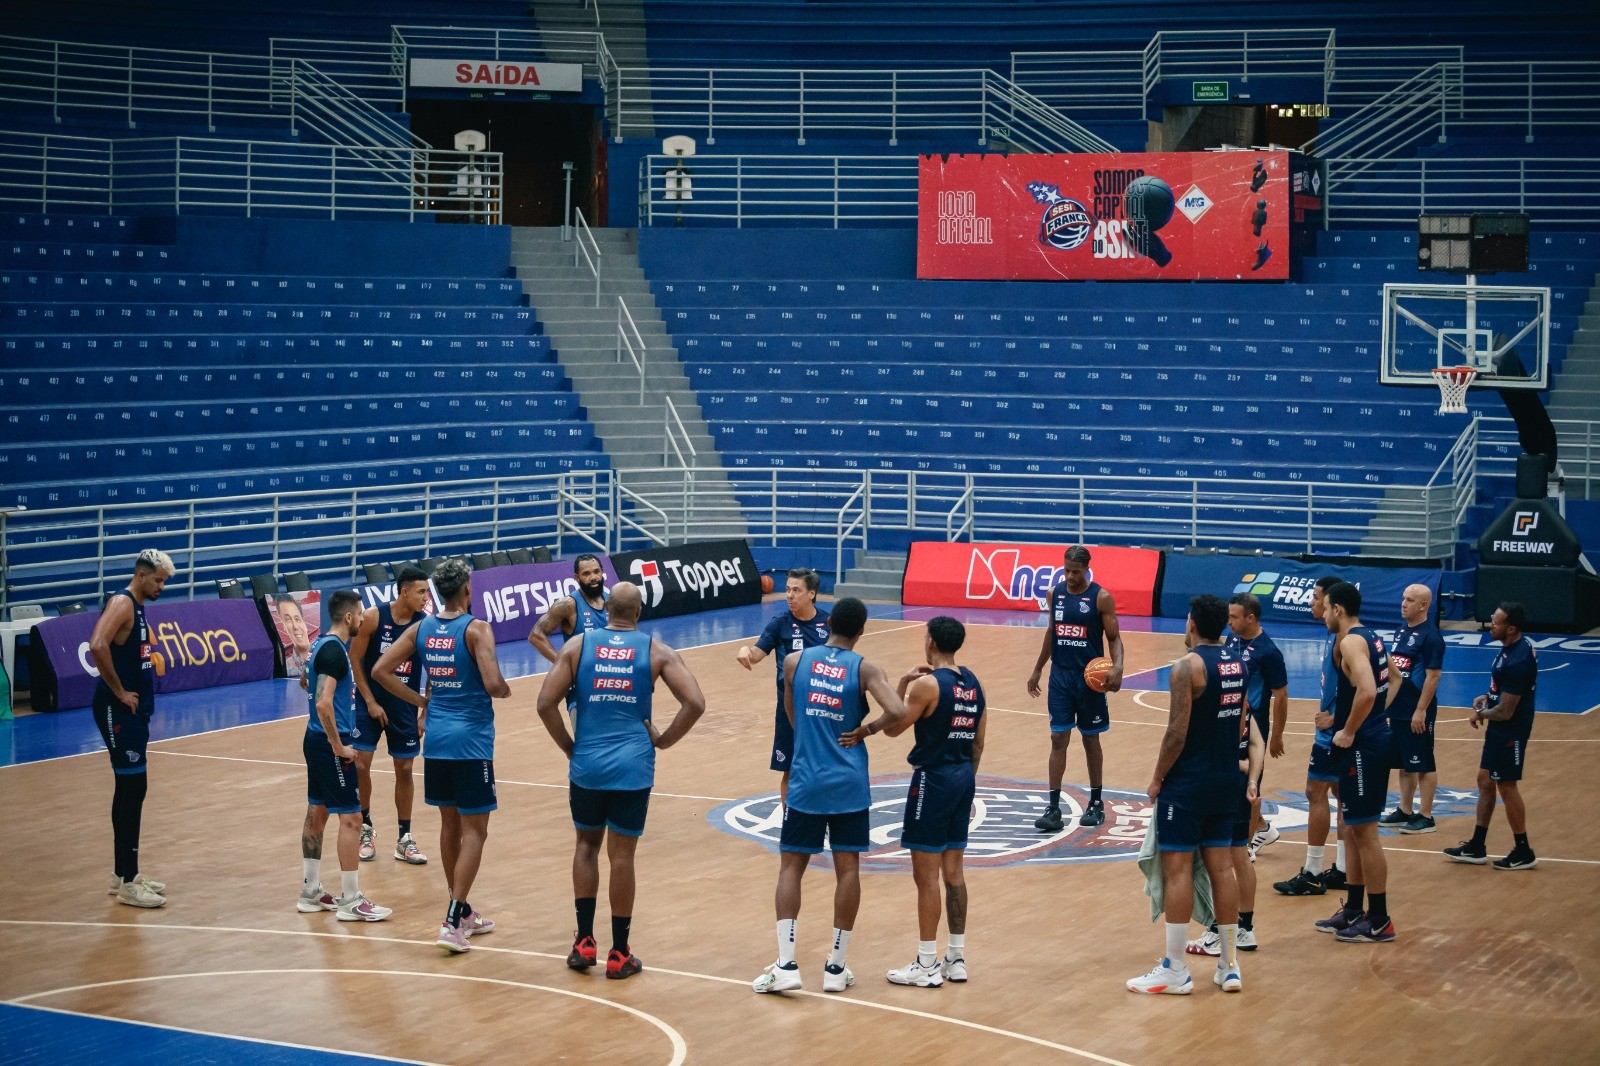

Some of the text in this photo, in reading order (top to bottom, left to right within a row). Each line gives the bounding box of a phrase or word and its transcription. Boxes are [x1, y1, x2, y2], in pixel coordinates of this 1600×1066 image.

[938, 190, 976, 217] LOJA
[1052, 204, 1073, 216] SESI
[938, 217, 993, 244] OFICIAL
[1333, 235, 1341, 243] 10
[1578, 237, 1586, 245] 17
[665, 283, 674, 293] 75
[732, 284, 740, 292] 77
[516, 311, 530, 320] 277
[953, 313, 965, 321] 141
[1156, 315, 1169, 323] 147
[404, 370, 416, 378] 421
[485, 370, 499, 378] 424
[698, 367, 712, 375] 242
[732, 367, 746, 375] 243
[768, 367, 782, 375] 244
[877, 368, 891, 376] 247
[1174, 404, 1189, 413] 307
[1359, 407, 1373, 416] 312
[1398, 408, 1412, 417] 313
[721, 426, 735, 434] 344
[830, 428, 844, 437] 347
[973, 430, 986, 439] 351
[1007, 431, 1021, 441] 352
[734, 457, 749, 465] 392
[917, 461, 930, 469] 397
[1062, 465, 1076, 473] 401
[1288, 471, 1303, 480] 407
[1493, 541, 1554, 553] FREEWAY
[663, 557, 745, 599] Topper
[1057, 625, 1084, 637] SESI
[428, 637, 453, 649] SESI
[425, 653, 455, 662] Unimed
[599, 647, 632, 660] SESI
[429, 667, 454, 676] FIESP
[594, 664, 634, 674] Unimed
[814, 662, 844, 679] SESI
[1220, 662, 1240, 675] SESI
[596, 678, 631, 689] FIESP
[810, 678, 844, 693] Unimed
[1221, 678, 1243, 688] Unimed
[588, 694, 637, 703] NETSHOES
[810, 692, 840, 706] FIESP
[805, 708, 845, 721] NETSHOES
